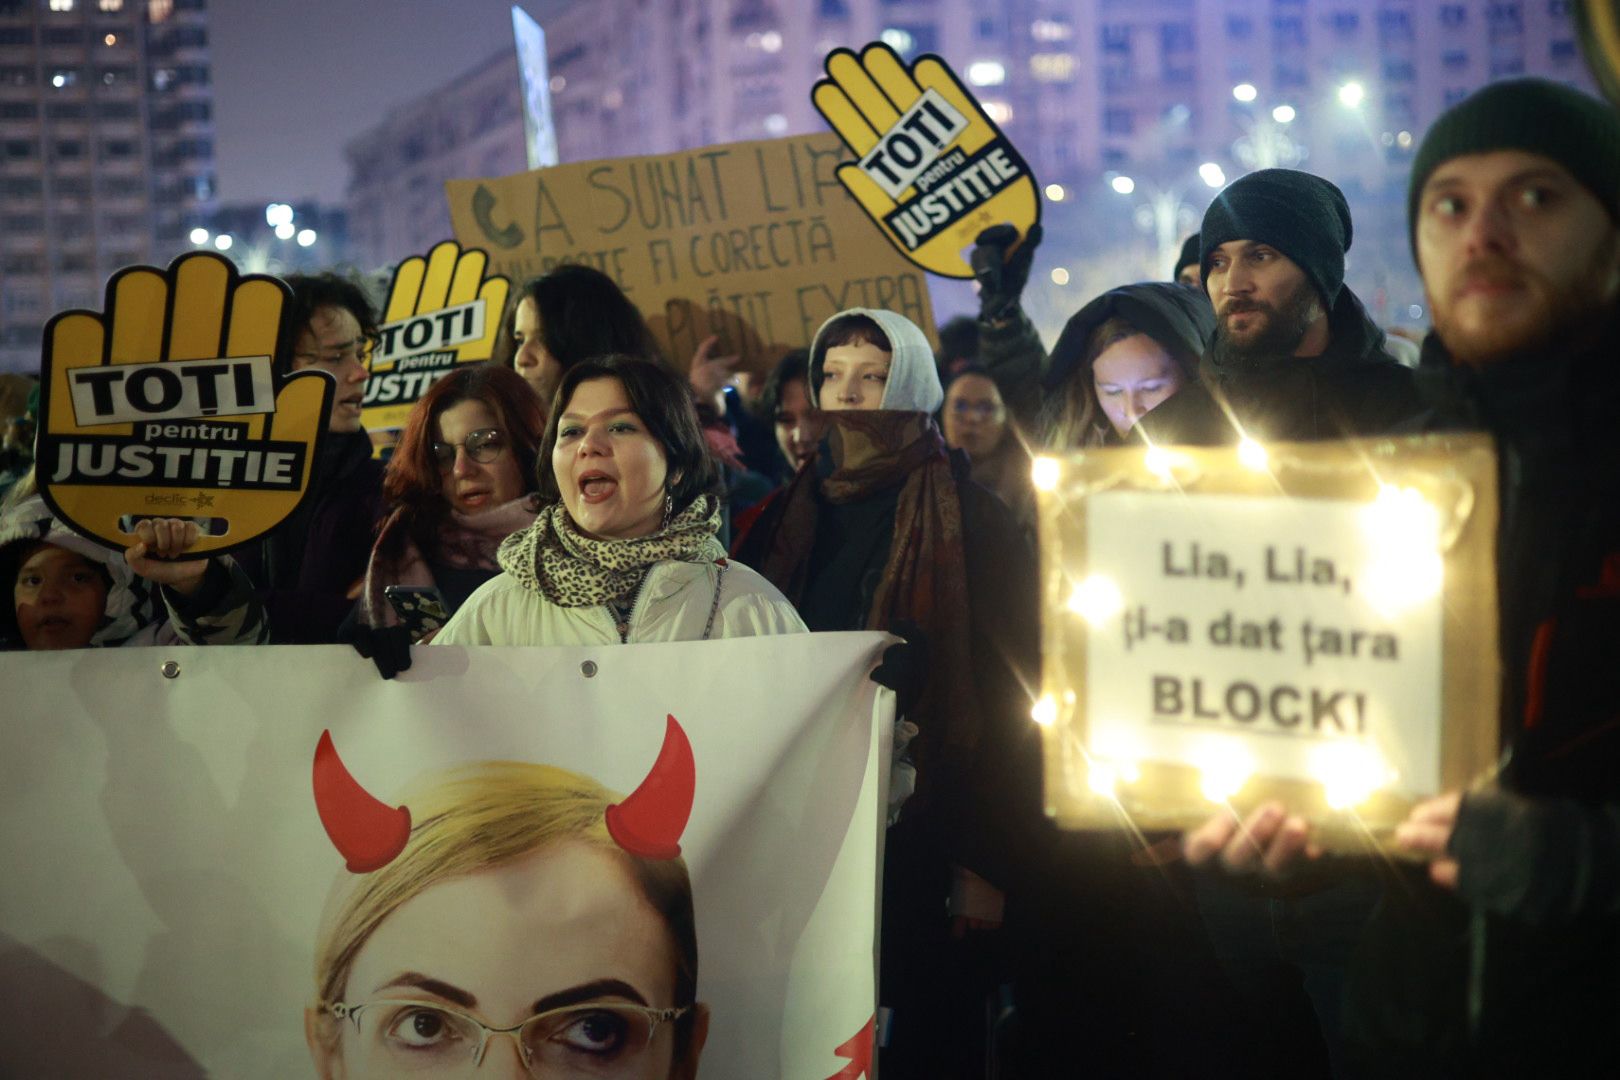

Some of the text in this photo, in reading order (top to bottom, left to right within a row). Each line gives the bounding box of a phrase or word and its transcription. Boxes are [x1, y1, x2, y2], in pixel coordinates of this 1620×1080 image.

[917, 150, 965, 192] pentru
[535, 177, 575, 251] A
[648, 239, 679, 284] FI
[689, 215, 837, 278] CORECTĂ
[399, 353, 453, 370] pentru
[75, 363, 256, 415] TOȚI
[363, 371, 452, 403] USTI
[144, 423, 239, 441] pentru
[52, 442, 296, 486] JUSTIȚIE
[1161, 541, 1352, 594] Lia, Lia,
[1208, 612, 1284, 652] dat
[1152, 675, 1367, 734] BLOCK!
